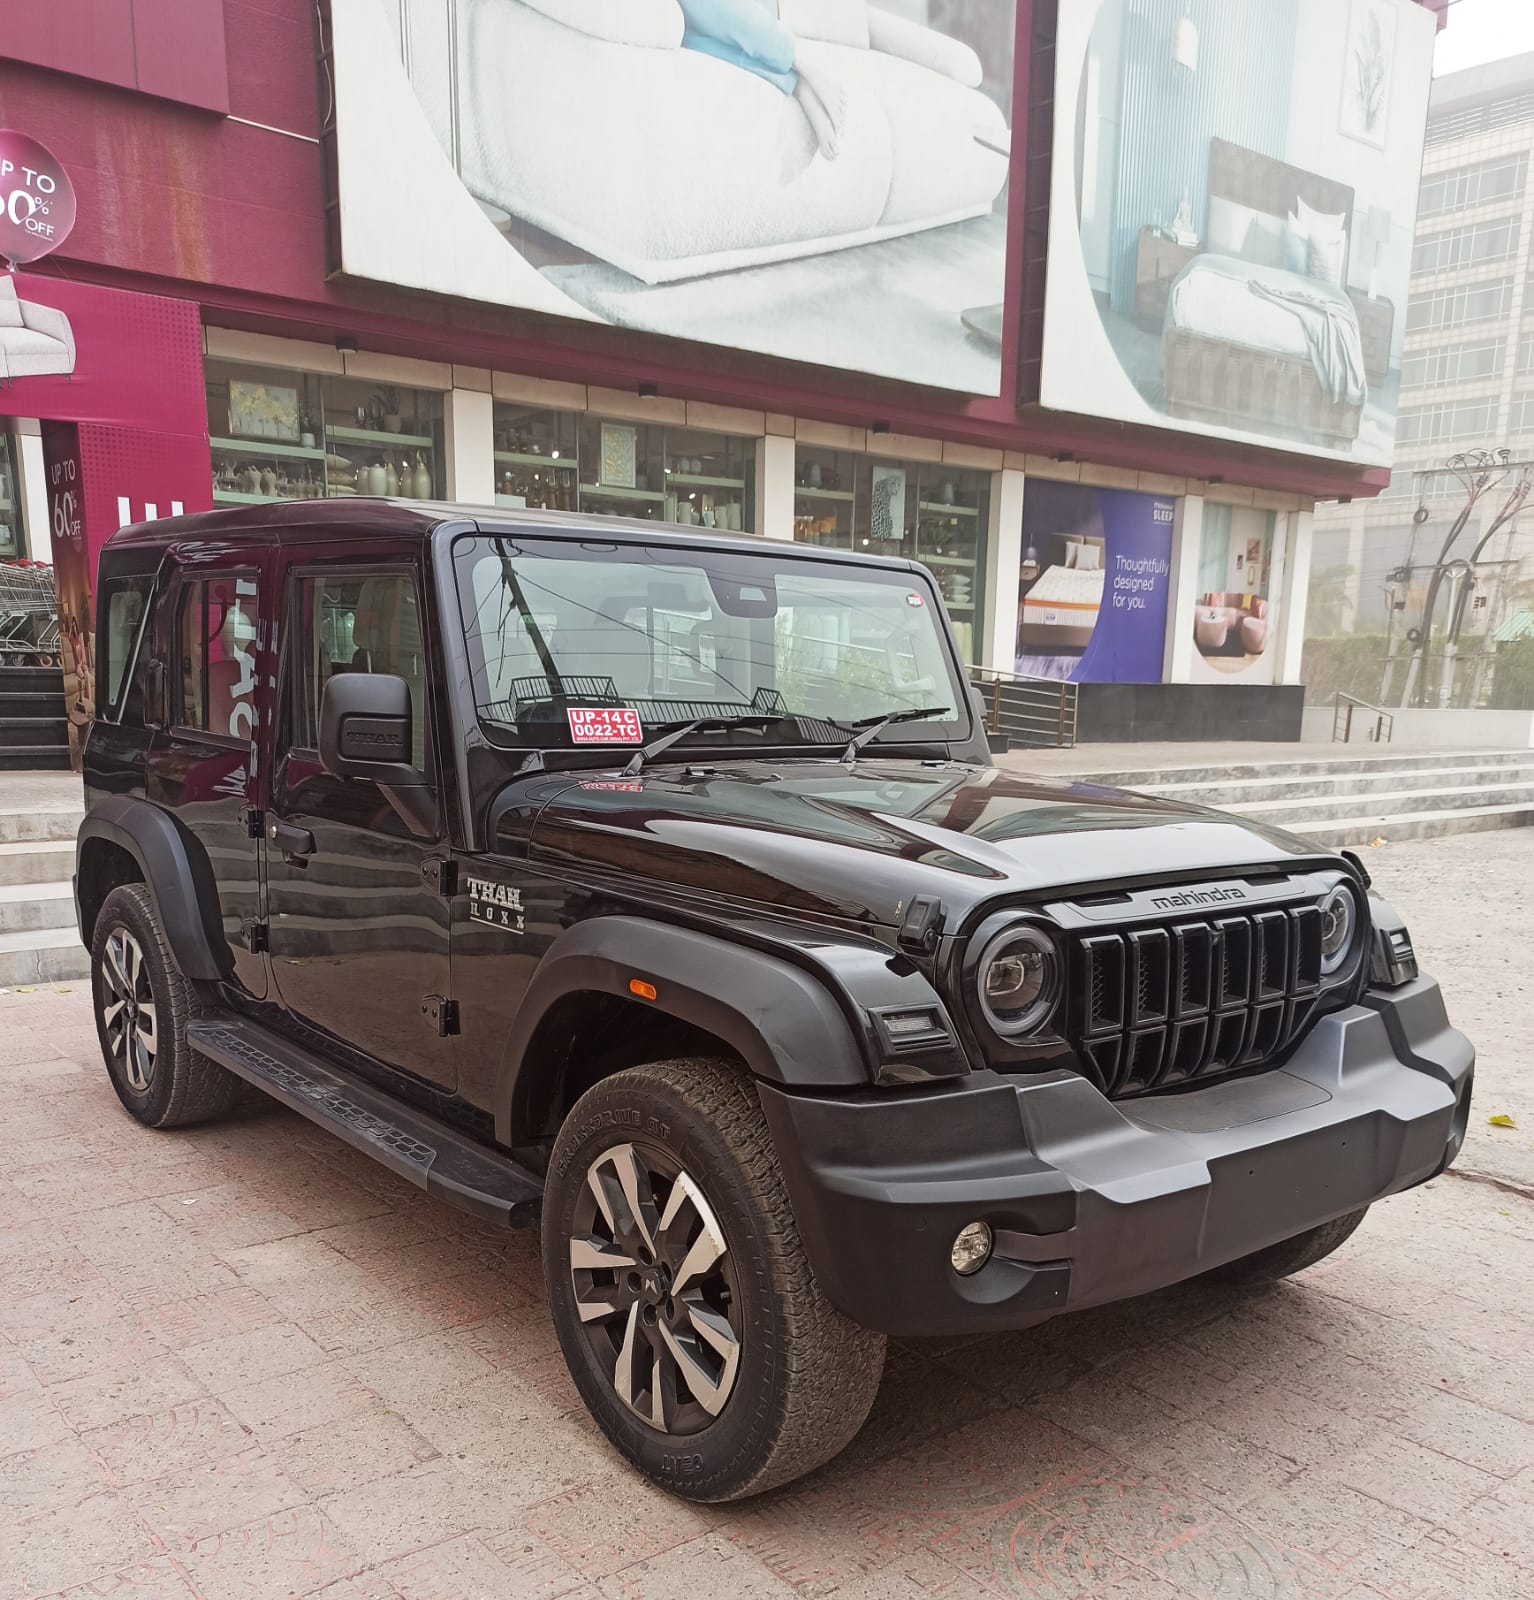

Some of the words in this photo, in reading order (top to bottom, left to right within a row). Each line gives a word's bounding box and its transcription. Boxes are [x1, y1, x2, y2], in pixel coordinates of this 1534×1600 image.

[0, 159, 14, 177] P
[21, 166, 56, 194] TO
[25, 217, 55, 237] OFF
[51, 463, 62, 486] UP
[62, 458, 76, 483] TO
[1153, 509, 1174, 523] SLEEP
[70, 520, 81, 537] OFF
[1115, 554, 1170, 577] Thoughtfully
[1113, 573, 1155, 593] designed
[1112, 591, 1127, 608] for
[1127, 596, 1147, 611] you.
[574, 724, 638, 737] 0022-TC
[1150, 887, 1246, 909] mahindra
